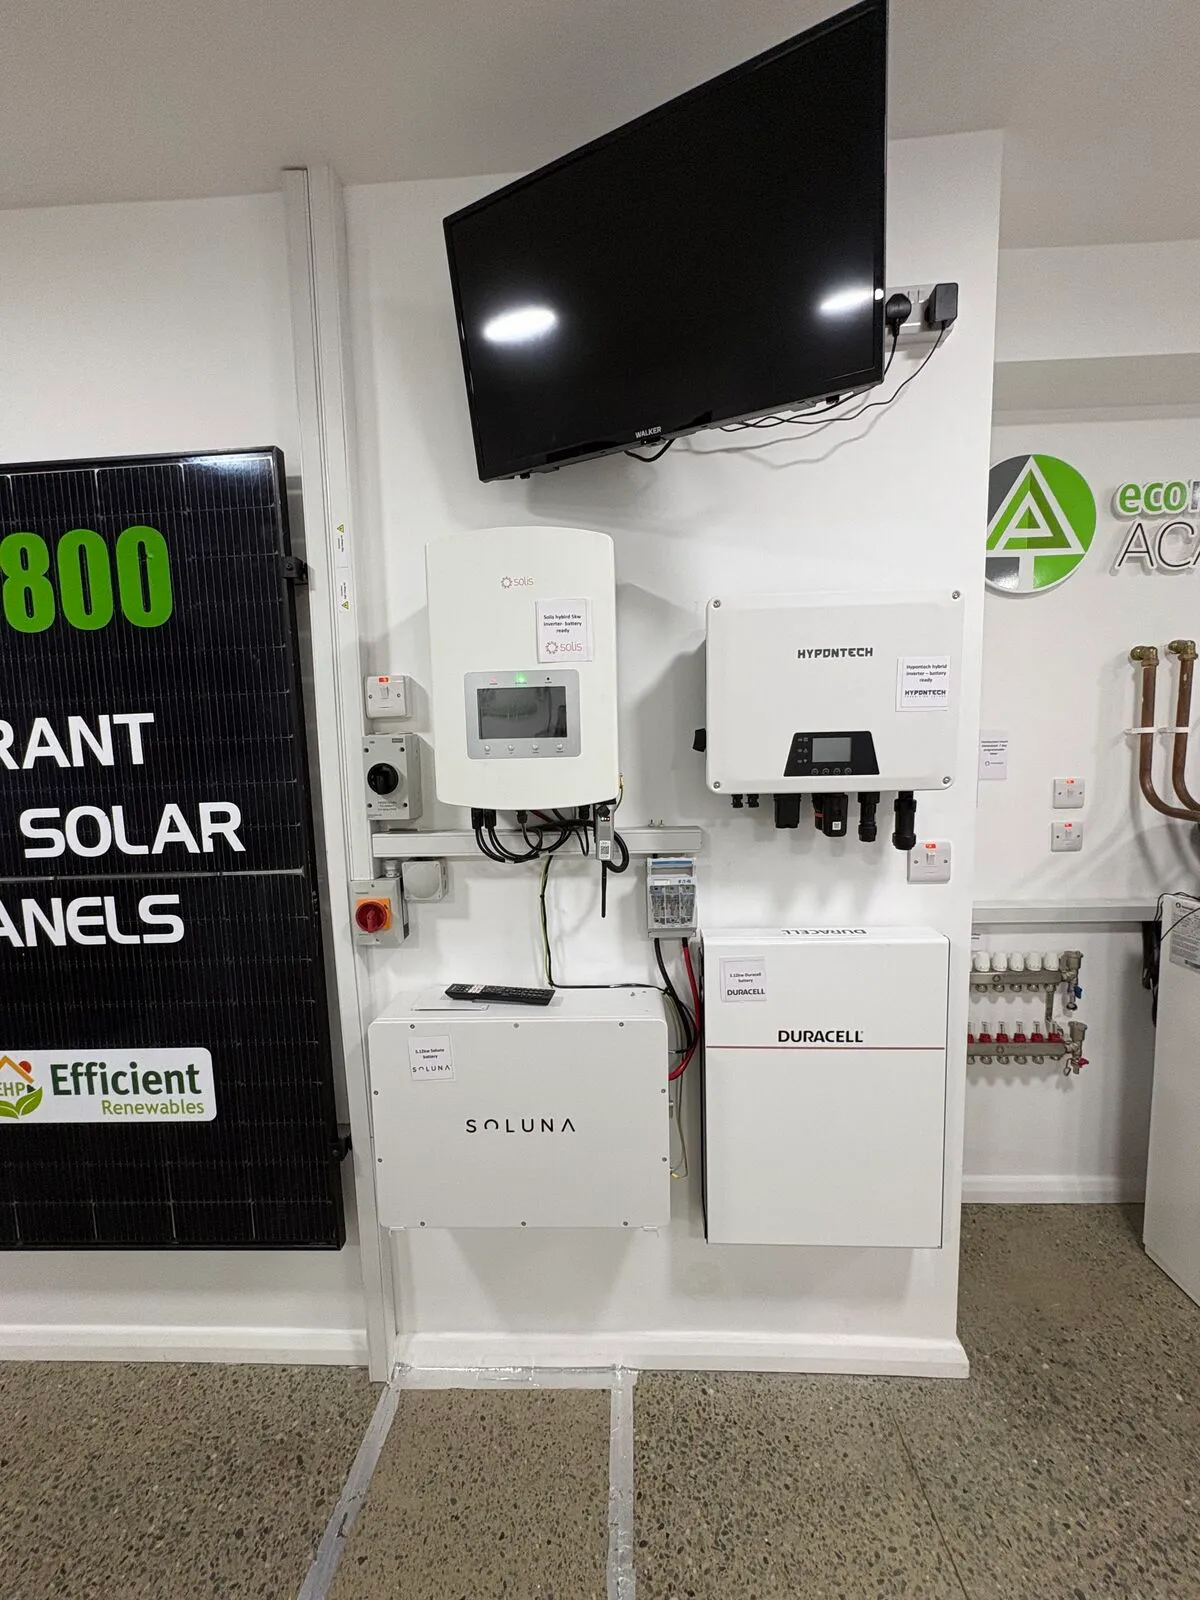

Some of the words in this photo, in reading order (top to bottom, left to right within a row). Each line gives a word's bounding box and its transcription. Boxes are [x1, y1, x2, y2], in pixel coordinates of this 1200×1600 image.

[635, 426, 662, 438] WALKER
[1118, 522, 1200, 567] AC
[0, 525, 173, 633] 800
[513, 576, 533, 586] solis
[560, 642, 582, 651] solis
[797, 647, 874, 659] HYPONTECH
[19, 801, 246, 859] SOLAR
[778, 1030, 863, 1043] DURACELL
[50, 1061, 202, 1096] Efficient
[101, 1099, 205, 1115] Renewables
[466, 1118, 576, 1133] SOLUNA
